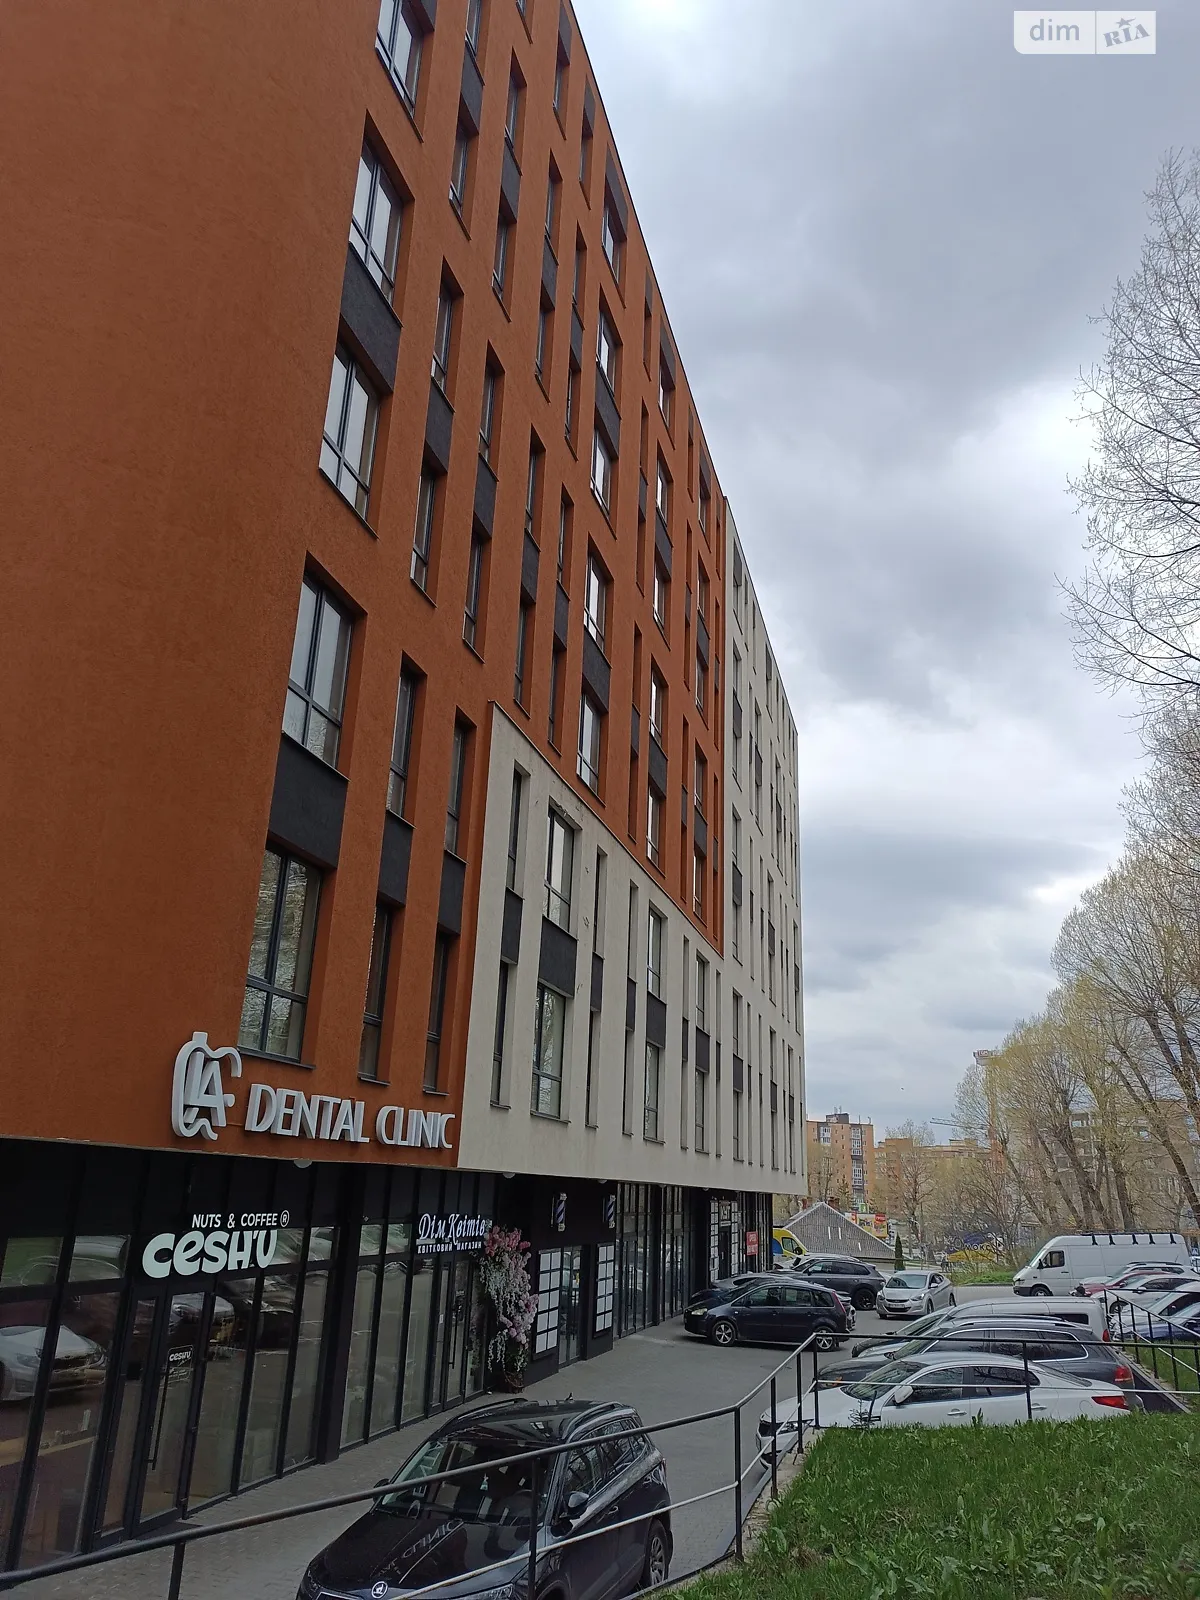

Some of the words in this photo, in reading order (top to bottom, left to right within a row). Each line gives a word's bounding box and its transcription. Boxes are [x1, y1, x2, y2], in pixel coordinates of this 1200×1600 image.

[245, 1083, 370, 1143] DENTAL
[376, 1105, 456, 1149] CLINIC
[191, 1213, 222, 1229] NUTS
[227, 1214, 236, 1229] &
[418, 1213, 447, 1240] Дім
[448, 1213, 486, 1246] Квітів
[417, 1242, 453, 1254] КВІТКОВИЙ
[456, 1241, 482, 1251] МАГАЗИН
